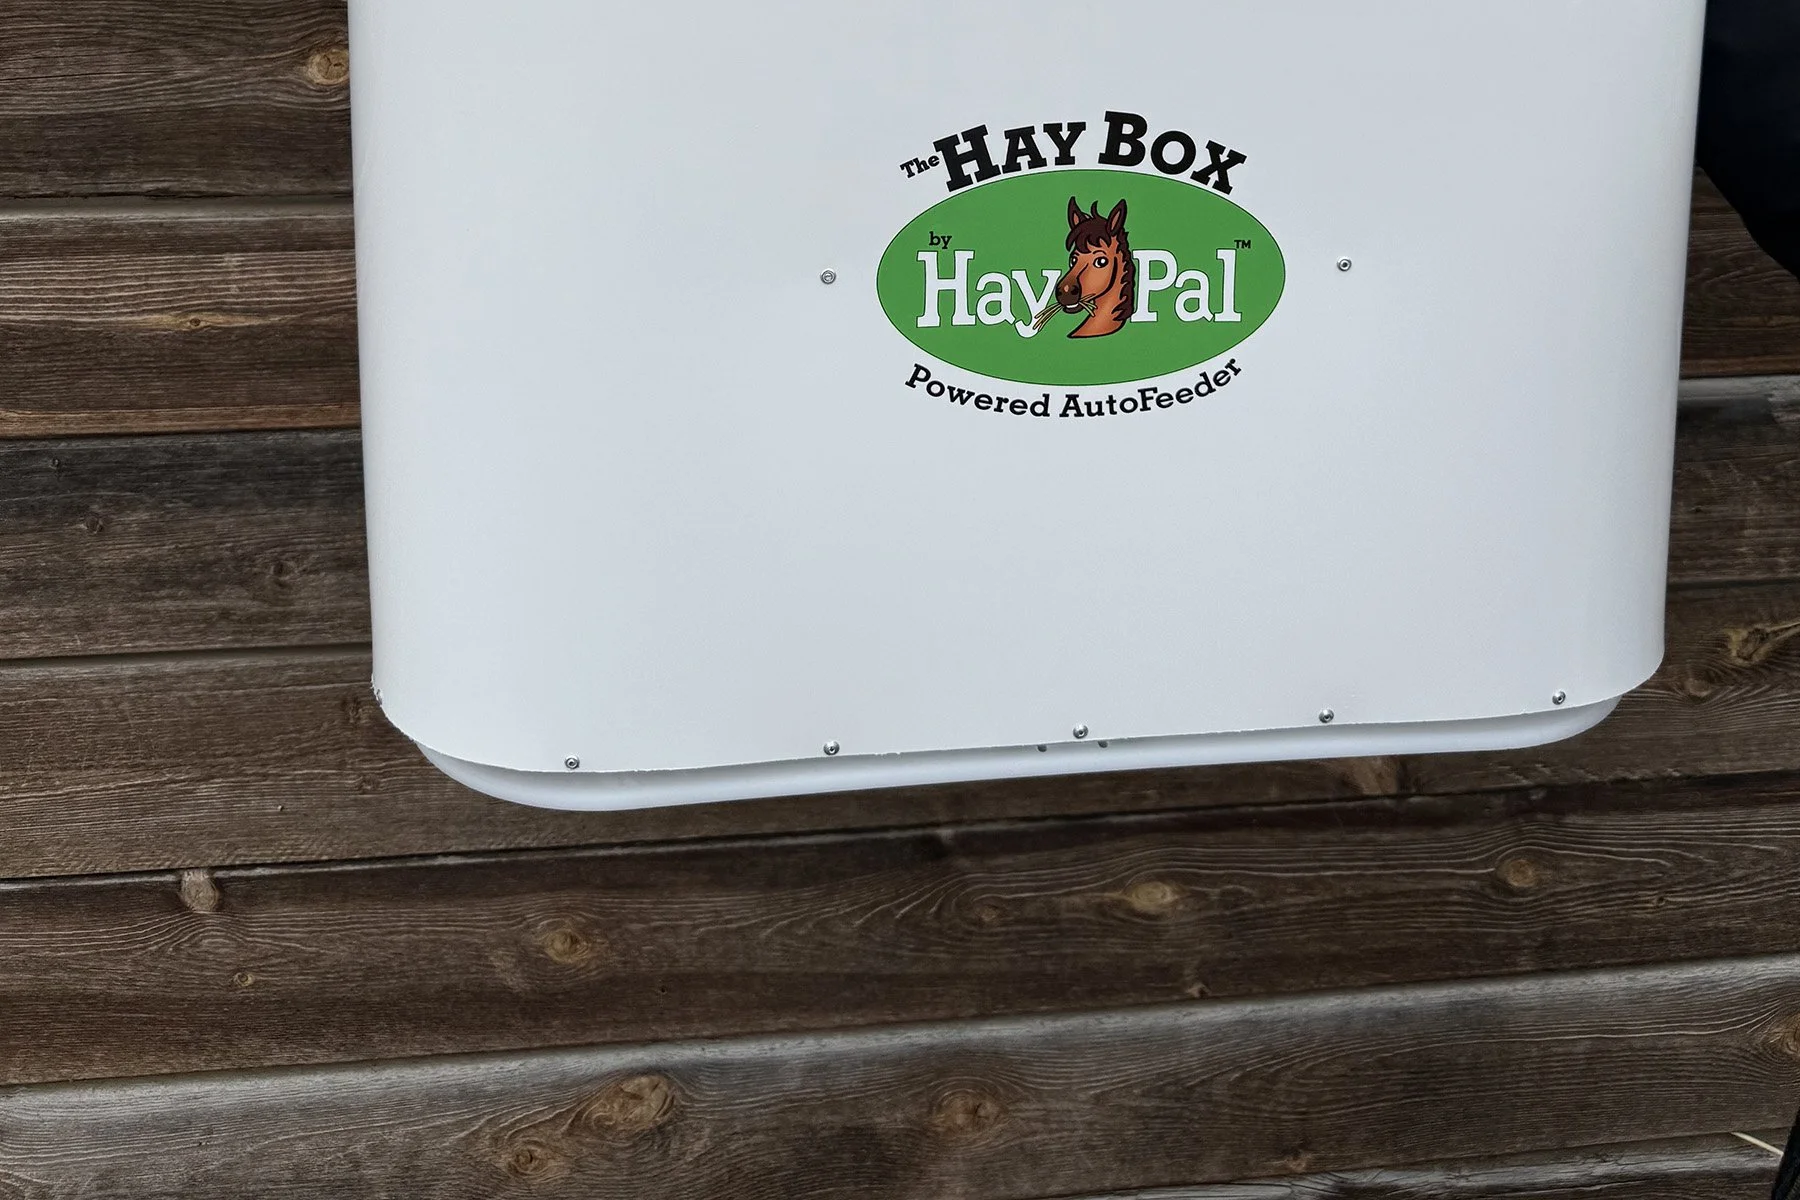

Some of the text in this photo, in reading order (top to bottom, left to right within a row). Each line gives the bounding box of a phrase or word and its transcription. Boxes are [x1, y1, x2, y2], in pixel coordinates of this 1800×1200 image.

[900, 154, 940, 178] The
[929, 231, 952, 249] by
[916, 250, 1061, 338] Hay
[1130, 249, 1242, 322] Pal
[905, 358, 1241, 418] Powered AutoFeeder
